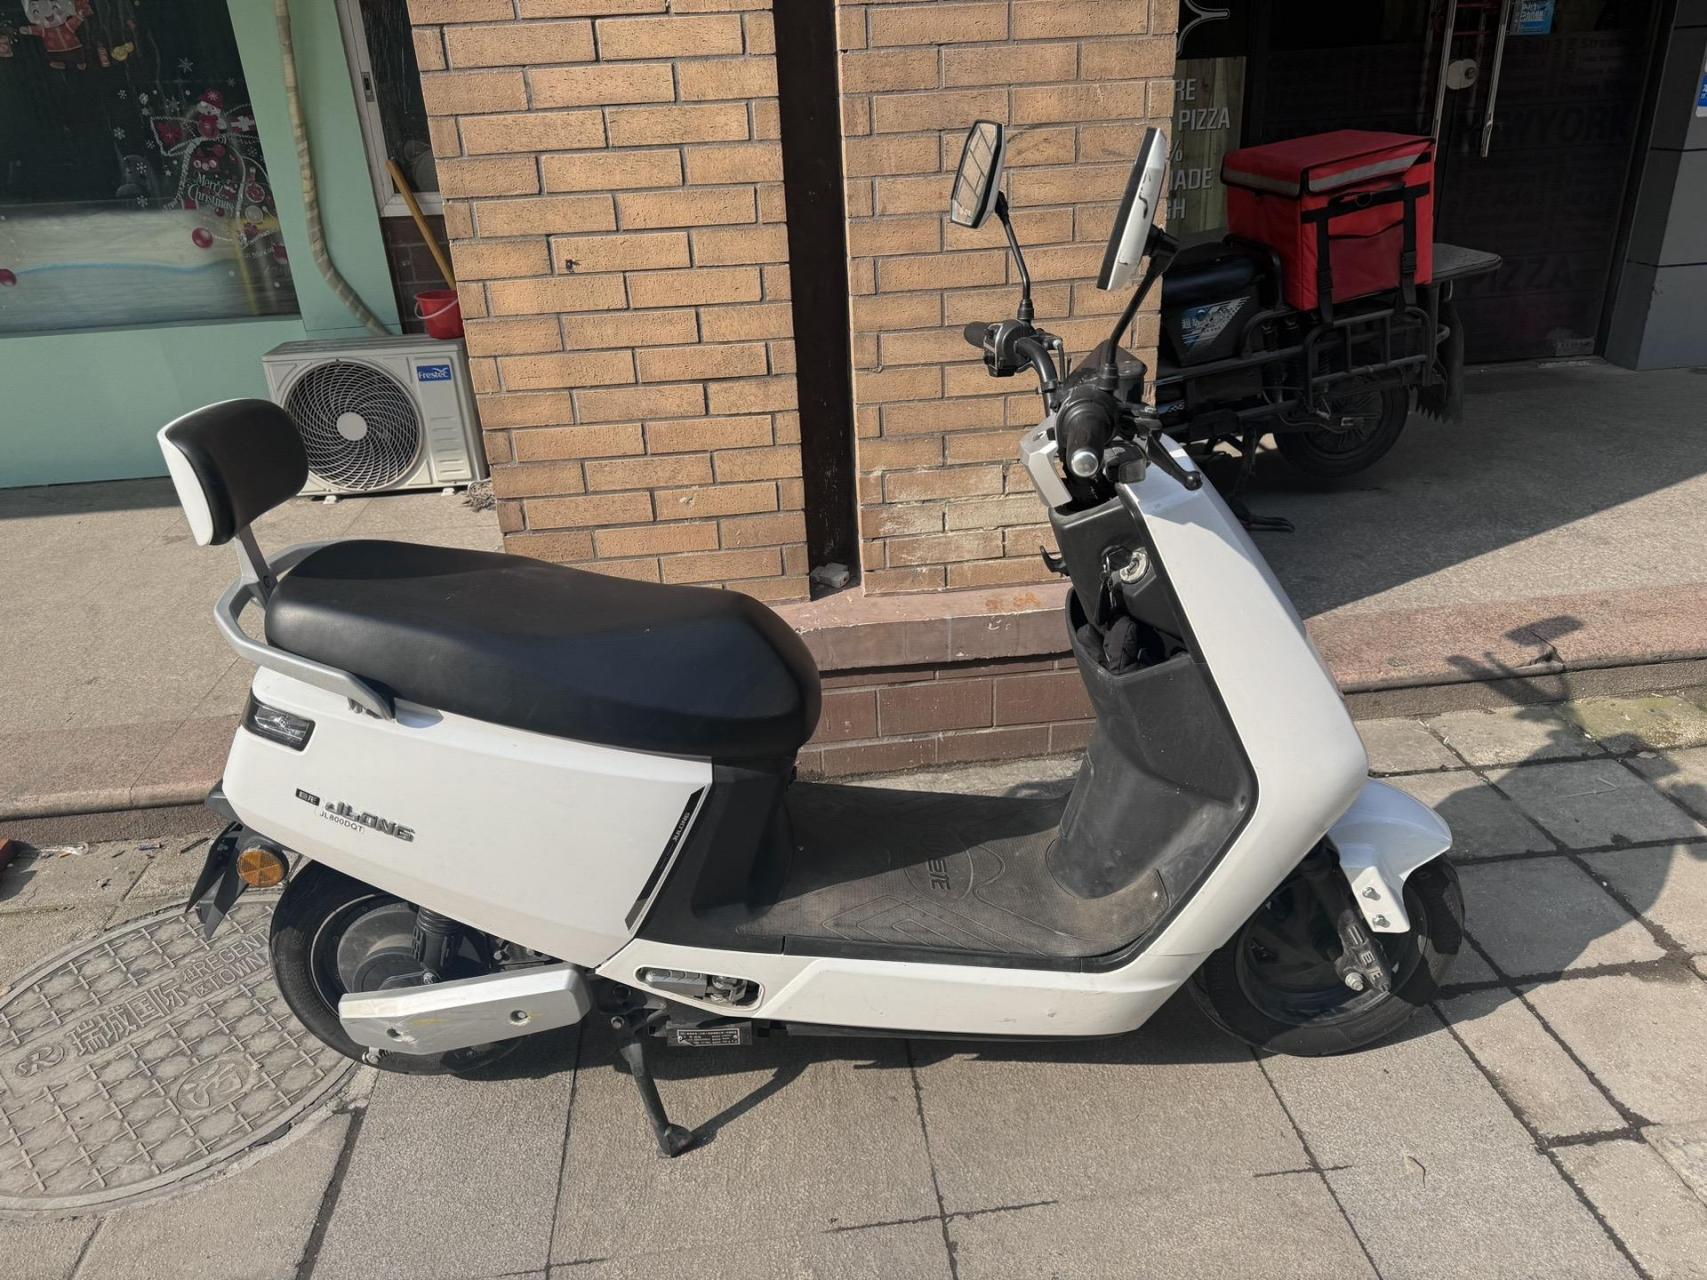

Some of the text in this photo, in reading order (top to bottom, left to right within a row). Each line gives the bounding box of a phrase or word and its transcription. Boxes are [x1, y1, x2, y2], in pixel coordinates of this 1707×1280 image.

[1178, 107, 1231, 131] PIZZA
[1170, 168, 1213, 190] ADE
[192, 927, 269, 977] REGENT
[210, 953, 265, 988] TOWN
[64, 979, 190, 1056] 瑞城国际
